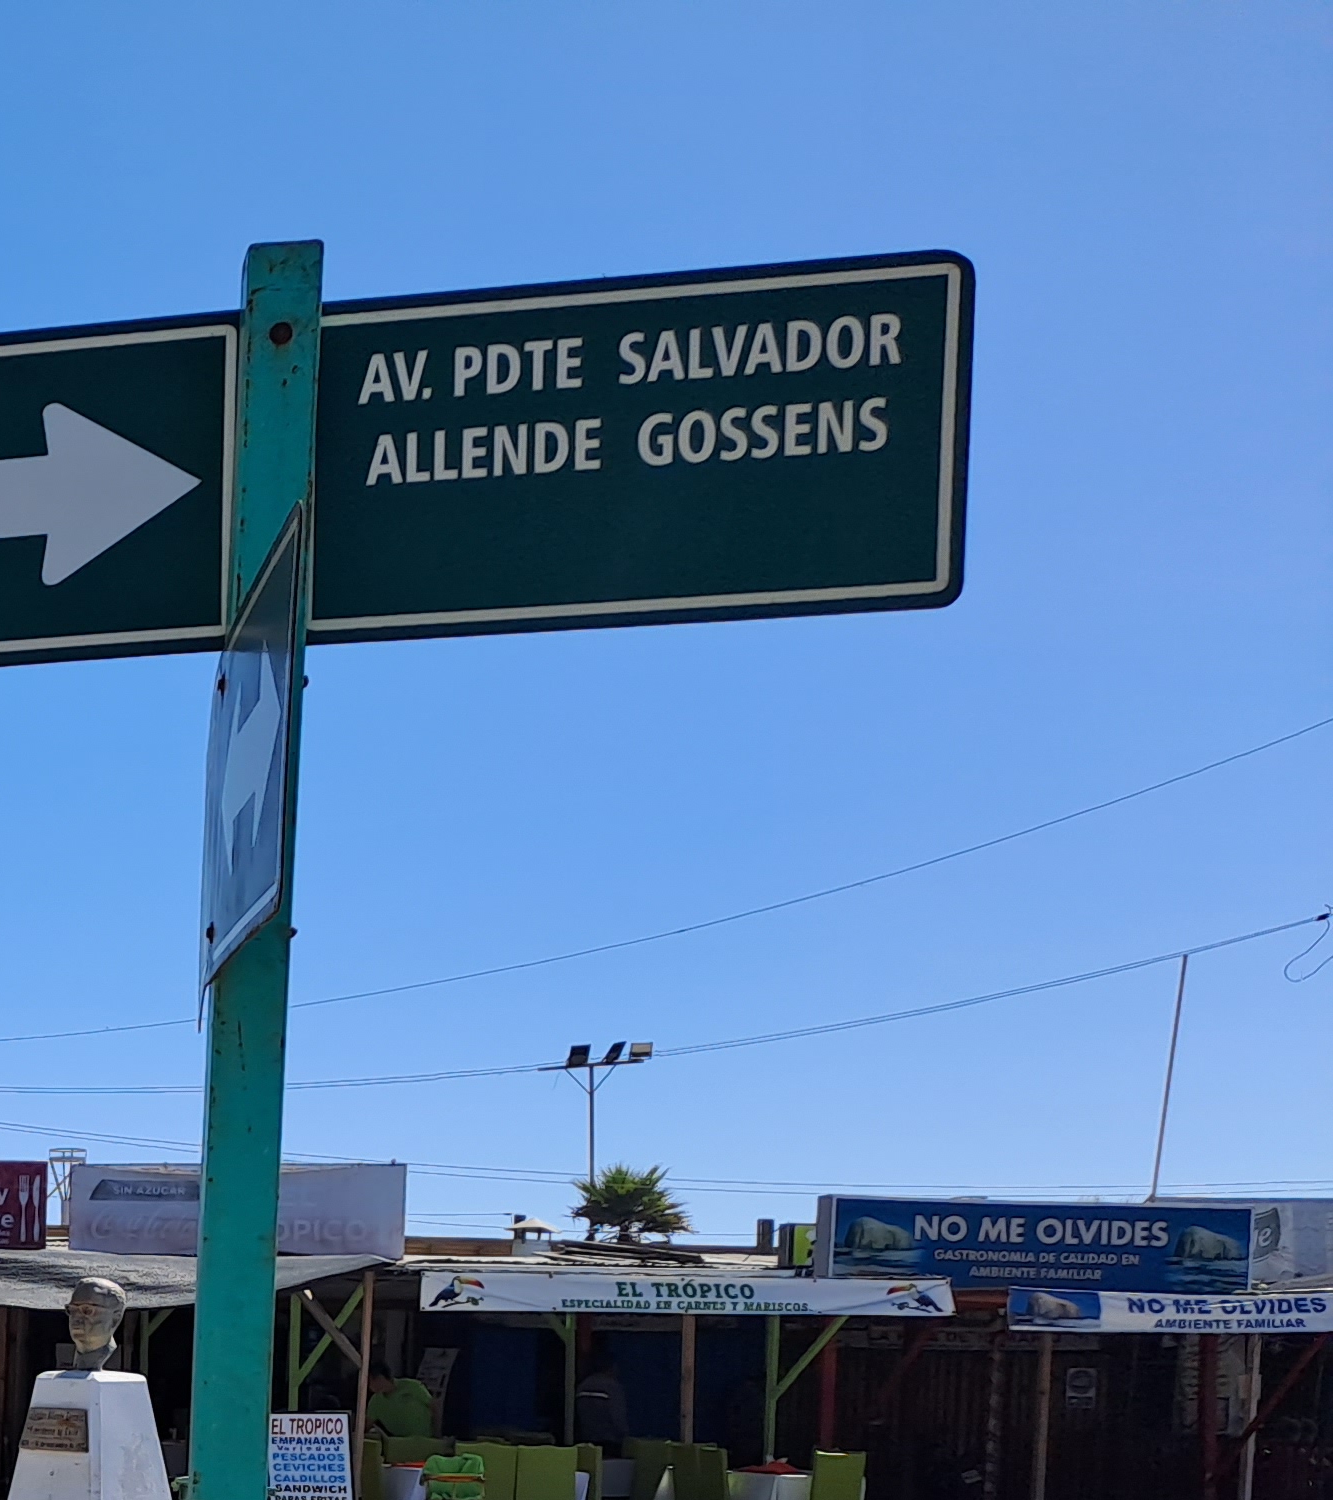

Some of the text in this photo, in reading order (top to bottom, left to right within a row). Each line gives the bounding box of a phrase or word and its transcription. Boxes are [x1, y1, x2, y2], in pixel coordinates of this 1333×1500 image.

[358, 312, 902, 404] AV. PDTE SALVADOR
[365, 396, 889, 487] ALLENDE GOSSENS
[113, 1186, 132, 1195] SIN
[277, 1219, 368, 1241] OPICO
[914, 1215, 1169, 1247] NO ME OLVIDES
[934, 1248, 1140, 1265] GASTRONOMIA DE CALIDAD EN
[969, 1265, 1102, 1281] AMBIENTE FAMILIAR
[615, 1279, 755, 1300] EL TRÓPICO
[561, 1299, 651, 1310] ESPECIALIDAD
[656, 1301, 672, 1310] EN
[677, 1301, 726, 1312] CARNES
[730, 1302, 738, 1311] Y
[1127, 1296, 1327, 1315] NO ME OLVIDES
[1154, 1317, 1307, 1329] AMBIENTE FAMILIAR
[271, 1418, 343, 1435] EL TROPICO
[271, 1436, 344, 1446] EMPANADAS
[273, 1452, 345, 1461] PESCADOS
[273, 1463, 346, 1472] CEVICHES
[274, 1474, 346, 1484] CALDILLOS
[275, 1484, 348, 1494] SANDWICH
